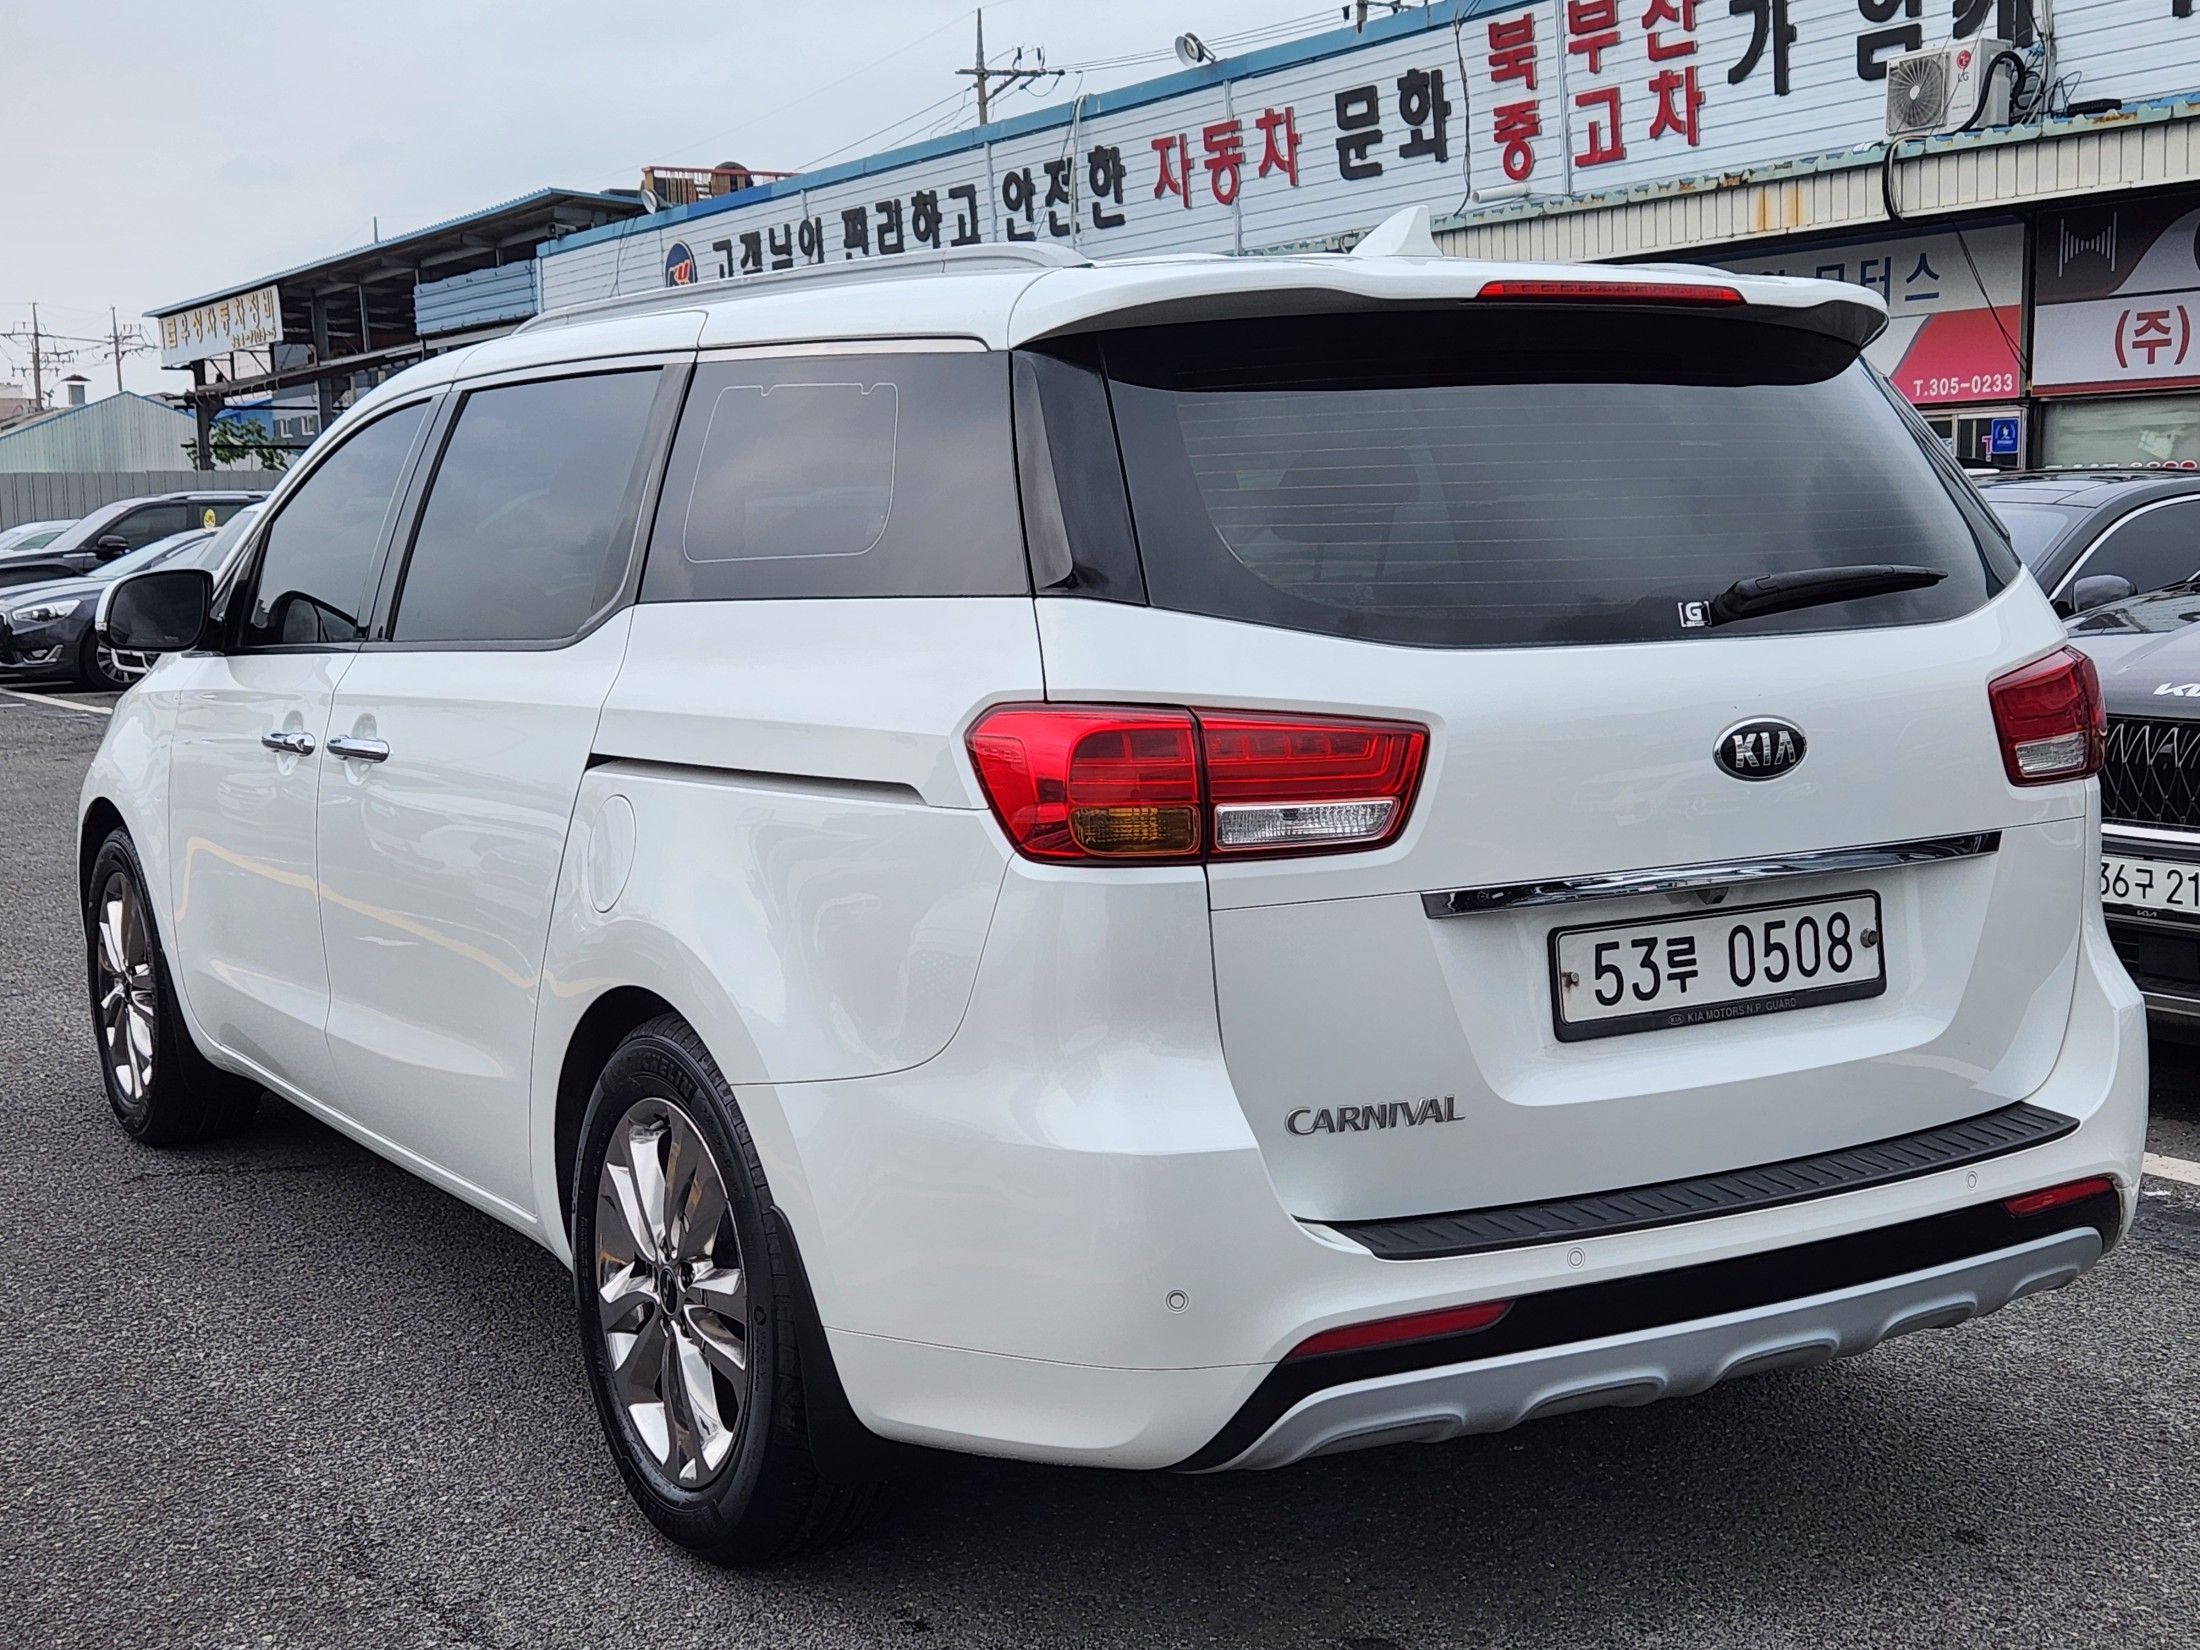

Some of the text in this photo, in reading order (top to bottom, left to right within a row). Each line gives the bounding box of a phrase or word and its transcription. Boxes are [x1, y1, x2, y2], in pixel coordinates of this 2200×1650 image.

[1488, 0, 1701, 90] 북부산
[1493, 65, 1706, 182] 중고차
[712, 216, 825, 279] 고객님이
[1001, 144, 1127, 242] 안전한
[1151, 106, 1302, 209] 자동차
[1334, 68, 1452, 181] 문화
[2114, 304, 2191, 369] (주)
[1913, 372, 2013, 397] T.305-0233
[1731, 729, 1797, 769] KIA
[1593, 911, 1854, 1007] 53루 0508
[1687, 1011, 1705, 1023] KIA
[1705, 1004, 1746, 1020] MOTORS
[1765, 997, 1797, 1012] GUARD
[1284, 1094, 1467, 1136] CARNIVAL
